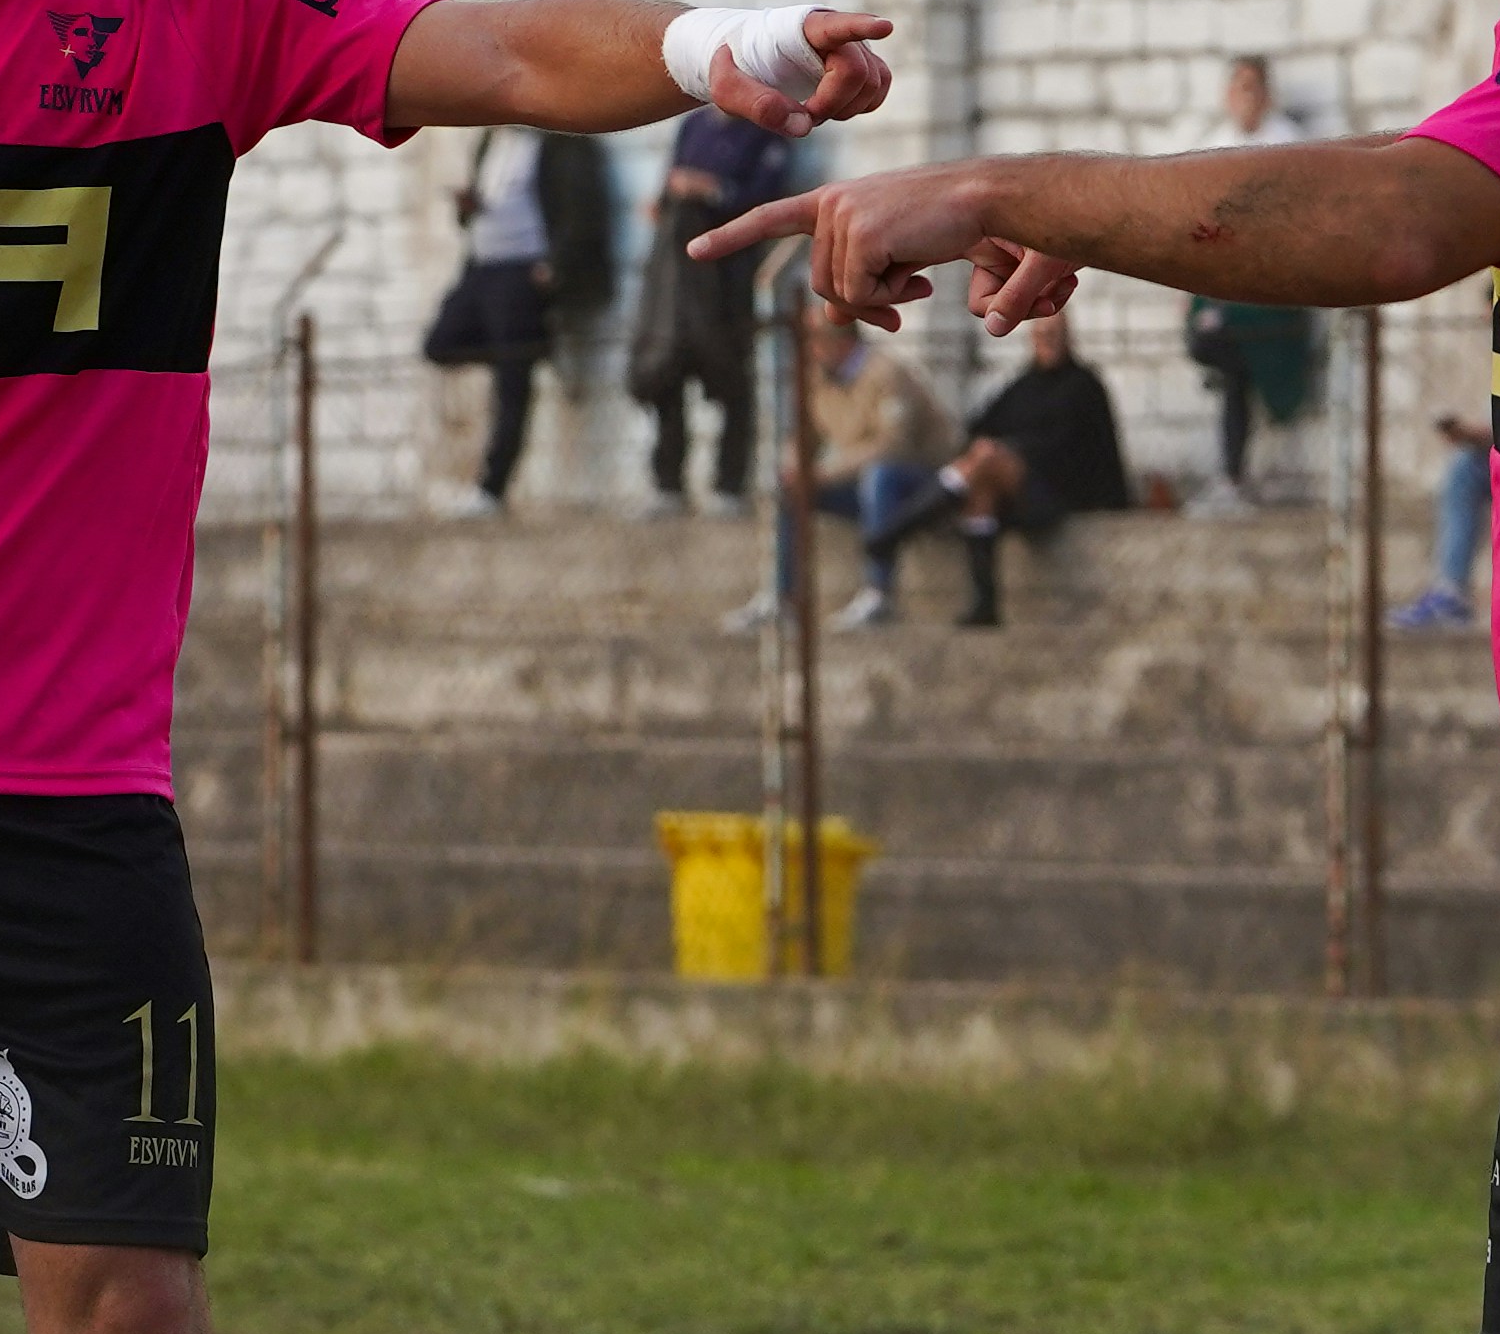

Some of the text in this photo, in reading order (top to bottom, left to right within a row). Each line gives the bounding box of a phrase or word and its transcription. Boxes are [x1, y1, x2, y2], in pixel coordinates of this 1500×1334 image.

[38, 83, 124, 116] EBVRVM
[122, 1000, 204, 1127] 11
[128, 1136, 199, 1168] EBVRVM
